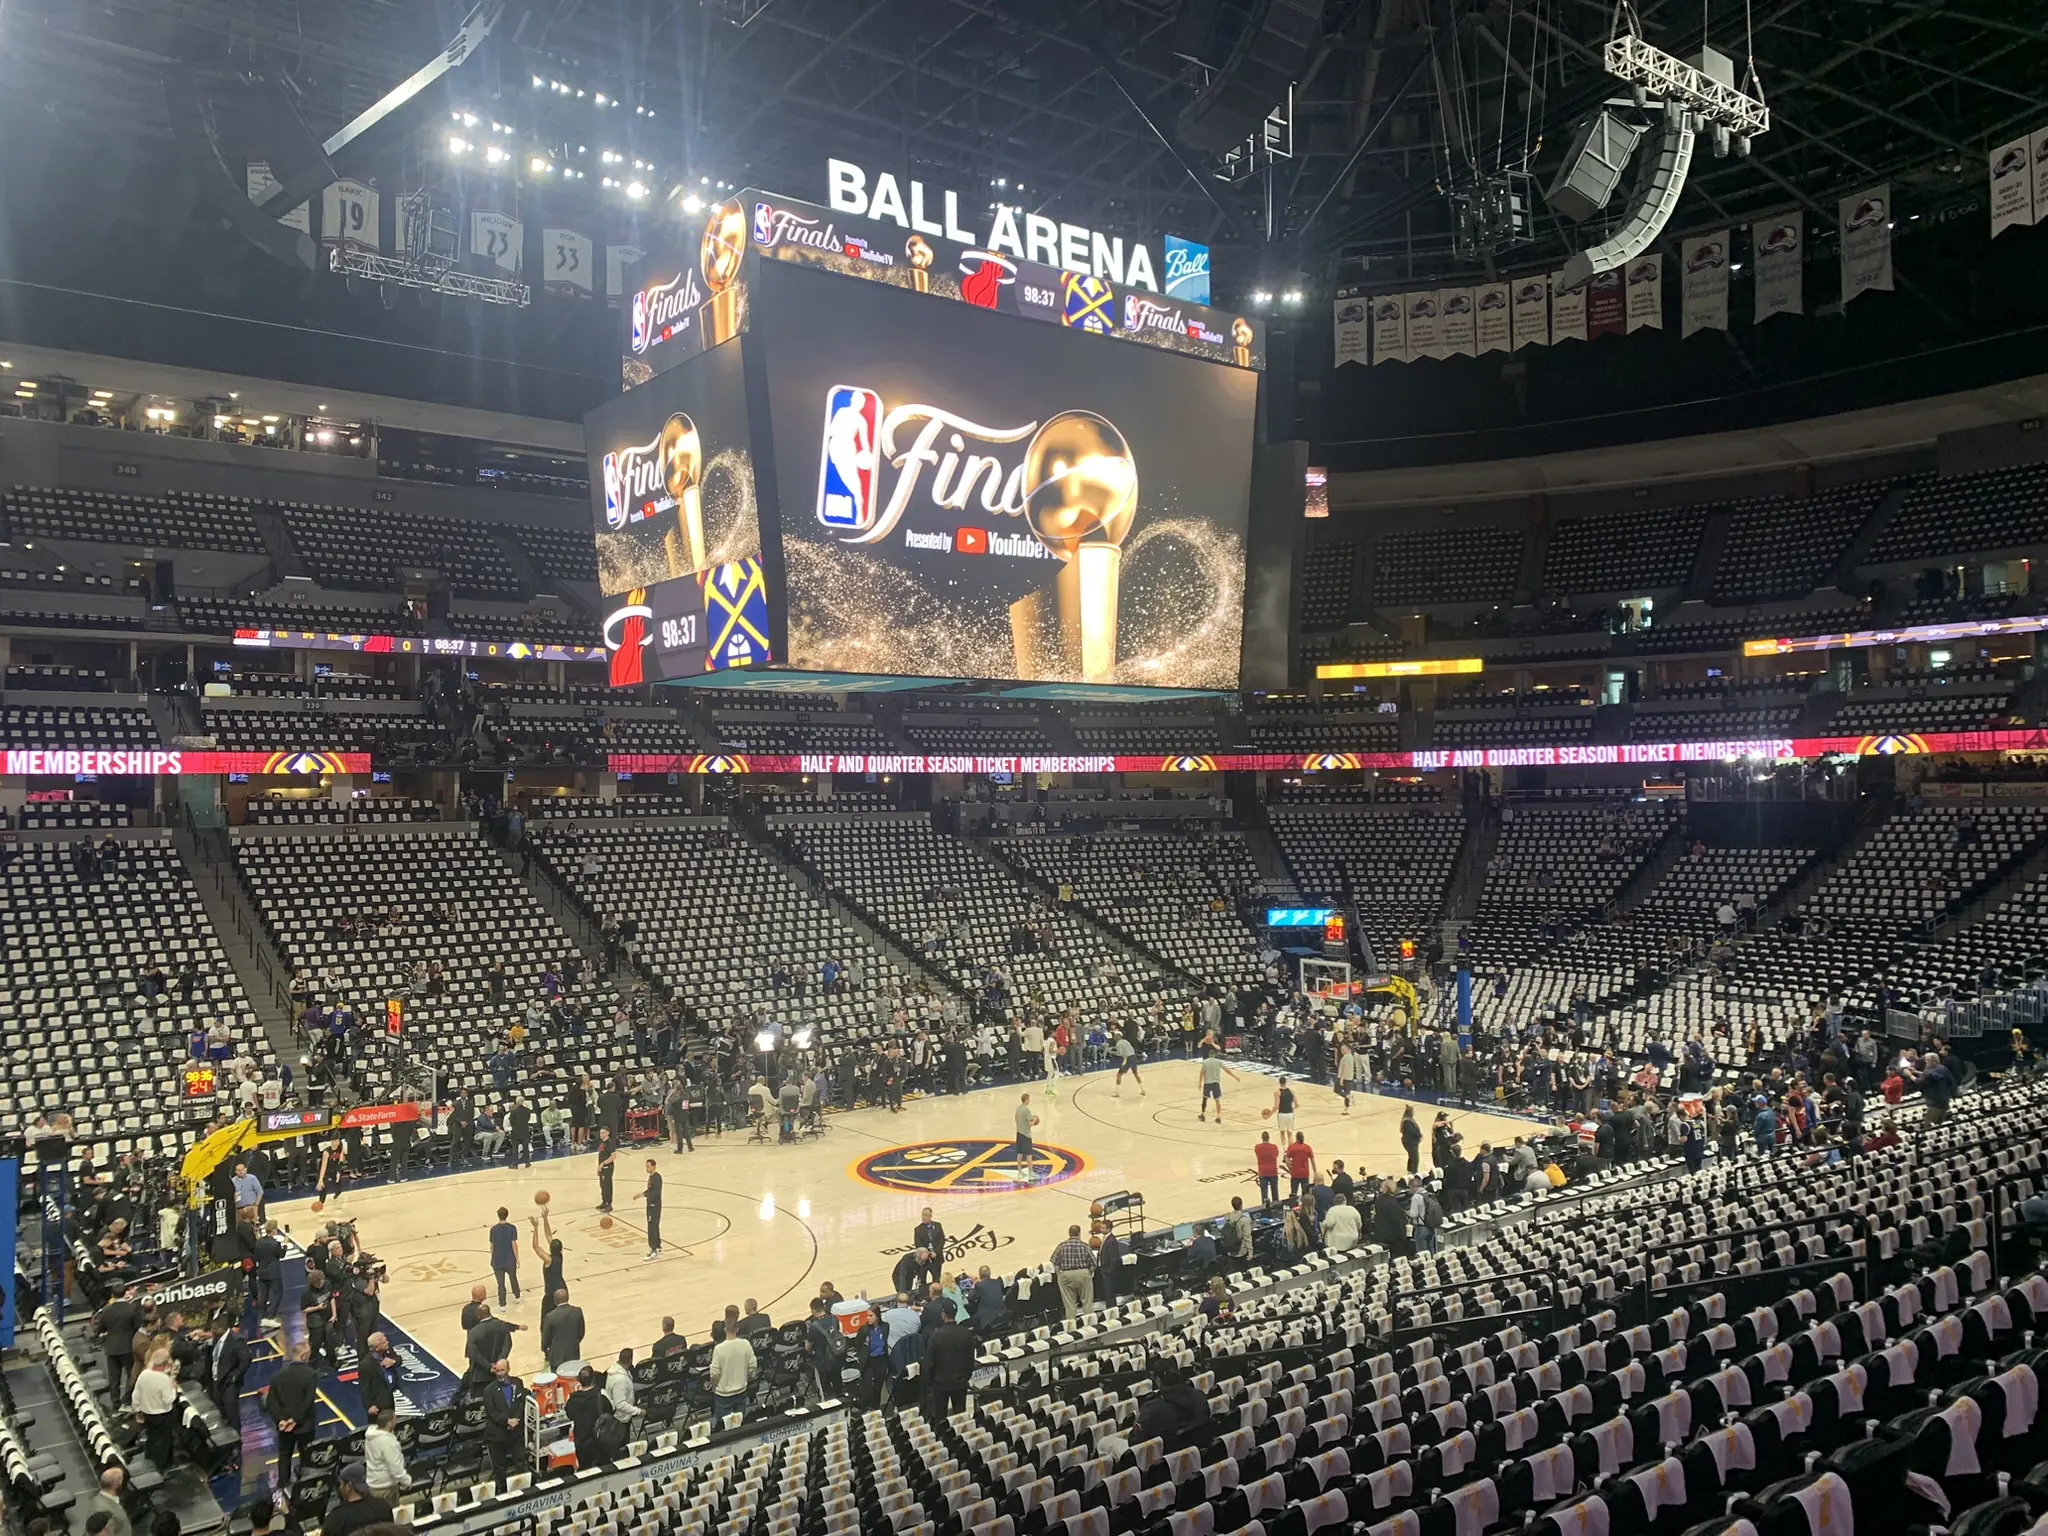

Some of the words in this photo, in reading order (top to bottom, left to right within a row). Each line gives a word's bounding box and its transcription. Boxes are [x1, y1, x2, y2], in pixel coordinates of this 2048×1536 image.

[338, 185, 364, 198] SAKIC
[339, 198, 364, 231] 19
[764, 210, 843, 254] Finals
[828, 158, 976, 246] BALL
[986, 205, 1159, 293] ARENA
[487, 229, 509, 258] 23
[560, 232, 577, 242] ROY
[556, 244, 579, 273] 33
[1166, 248, 1209, 280] Ball
[1024, 285, 1055, 307] 98:37
[638, 268, 701, 354] Finals
[1130, 300, 1188, 334] Finals
[117, 465, 137, 475] 340
[375, 492, 393, 500] 342
[905, 528, 942, 550] Presented
[942, 531, 953, 554] by
[662, 614, 696, 648] 98:37
[353, 642, 360, 651] 0
[402, 640, 411, 651] 0
[434, 639, 465, 650] 98:37
[470, 648, 476, 656] 7
[488, 645, 497, 655] 0
[536, 651, 543, 659] 0
[306, 702, 320, 710] 230
[1412, 751, 1449, 768] HALF
[1453, 749, 1483, 767] AND
[1487, 747, 1555, 766] QUARTER
[1559, 745, 1618, 764] SEASON
[1621, 743, 1676, 763] TICKET
[1680, 739, 1795, 760] MEMBERSHIPS
[6, 751, 182, 775] MEMBERSHIPS
[801, 755, 833, 773] HALF
[838, 755, 864, 773] AND
[868, 755, 924, 773] QUARTER
[927, 755, 973, 773] SEASON
[975, 756, 1016, 773] TICKET
[1020, 756, 1115, 773] MEMBERSHIPS
[1327, 926, 1342, 940] 24
[190, 1081, 208, 1095] 24
[273, 1114, 301, 1129] Finals
[313, 1113, 321, 1121] TV
[215, 1210, 227, 1219] GET
[141, 1281, 228, 1307] coinbase
[851, 1314, 860, 1326] G
[545, 1390, 554, 1398] G
[769, 1419, 814, 1441] GRAVINA'S
[650, 1453, 700, 1476] GRAVINA'S
[517, 1489, 572, 1514] GRAVINA'S
